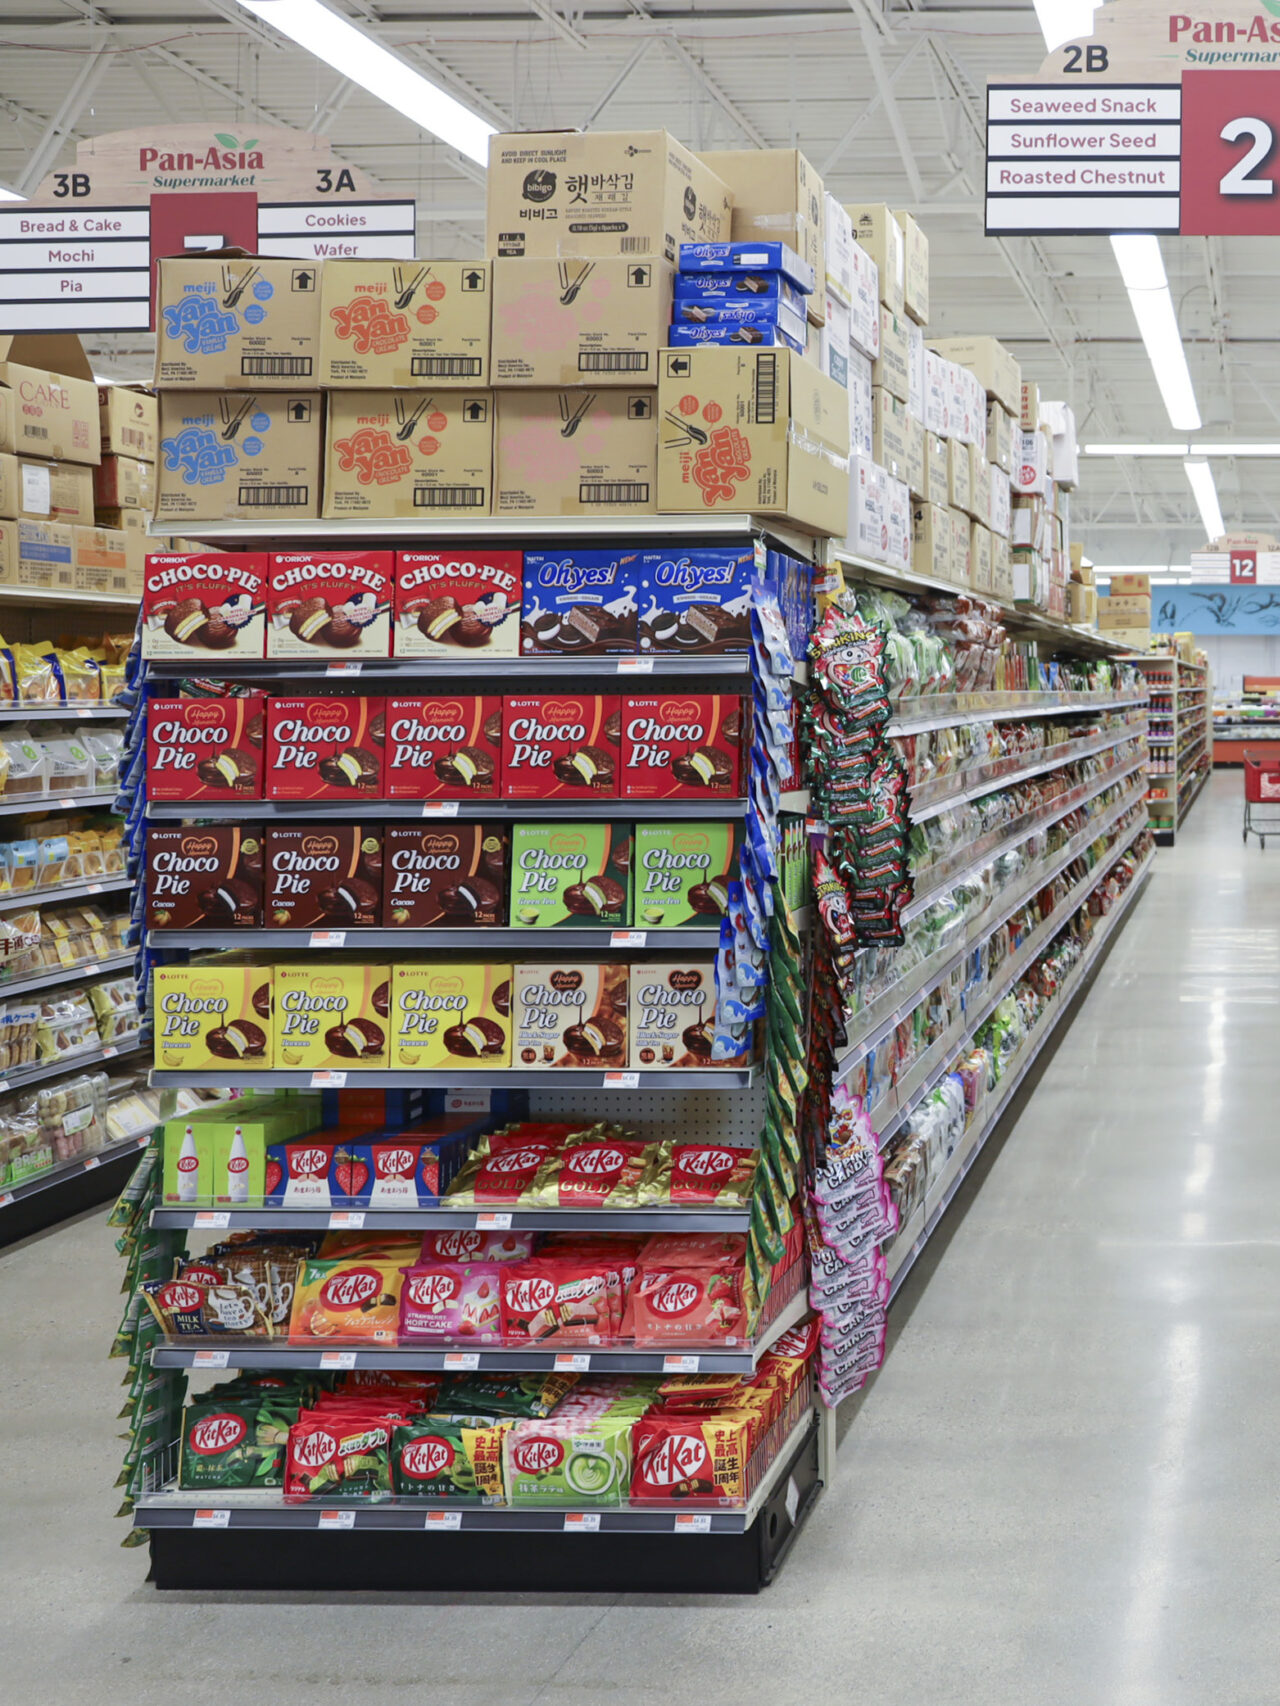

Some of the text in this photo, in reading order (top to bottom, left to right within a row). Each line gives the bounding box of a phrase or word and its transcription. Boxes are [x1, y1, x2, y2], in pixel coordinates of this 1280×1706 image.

[1063, 45, 1109, 73] 2B
[1010, 97, 1157, 114] Seaweed Snack
[1010, 132, 1157, 149] Sunflower Seed
[139, 146, 264, 171] Pan-Asia
[1219, 116, 1274, 194] 2
[53, 174, 91, 197] 3B
[153, 174, 257, 189] Supermarket
[316, 169, 356, 192] 3A
[999, 168, 1165, 185] Roasted Chestnut
[527, 184, 552, 193] bibigo
[305, 214, 366, 227] Cookies
[520, 208, 558, 220] 비비고
[20, 219, 122, 233] Bread & Cake
[48, 249, 94, 262] Mochi
[314, 243, 358, 256] Wafer
[61, 280, 83, 292] Pia
[184, 282, 216, 293] meiji
[355, 282, 387, 294] meiji
[20, 381, 70, 409] CAKE
[182, 414, 215, 426] meiji
[357, 414, 389, 425] meiji
[1232, 559, 1254, 577] 12
[196, 583, 232, 592] FLUFFY
[152, 722, 228, 743] Choco
[273, 721, 350, 742] Choco
[509, 719, 585, 741] Choco
[627, 719, 703, 740] Choco
[152, 747, 196, 770] Pie
[273, 746, 317, 768] Pie
[509, 744, 552, 768] Pie
[627, 744, 669, 768] Pie
[152, 852, 219, 872] Choco
[272, 852, 339, 872] Choco
[519, 850, 587, 869] Choco
[642, 850, 711, 869] Choco
[152, 875, 190, 894] Pie
[272, 874, 310, 894] Pie
[519, 872, 557, 892] Pie
[643, 872, 681, 892] Pie
[292, 1150, 328, 1172] KitKat
[379, 1150, 414, 1172] KitKat
[486, 1151, 541, 1172] KitKat
[569, 1149, 623, 1173] KitKat
[478, 1178, 525, 1190] GOLD
[561, 1180, 610, 1194] GOLD
[673, 1180, 721, 1191] GOLD
[177, 1315, 199, 1323] MILK
[714, 1430, 736, 1443] 史上
[715, 1443, 736, 1455] 最高
[713, 1457, 739, 1470] 誕生
